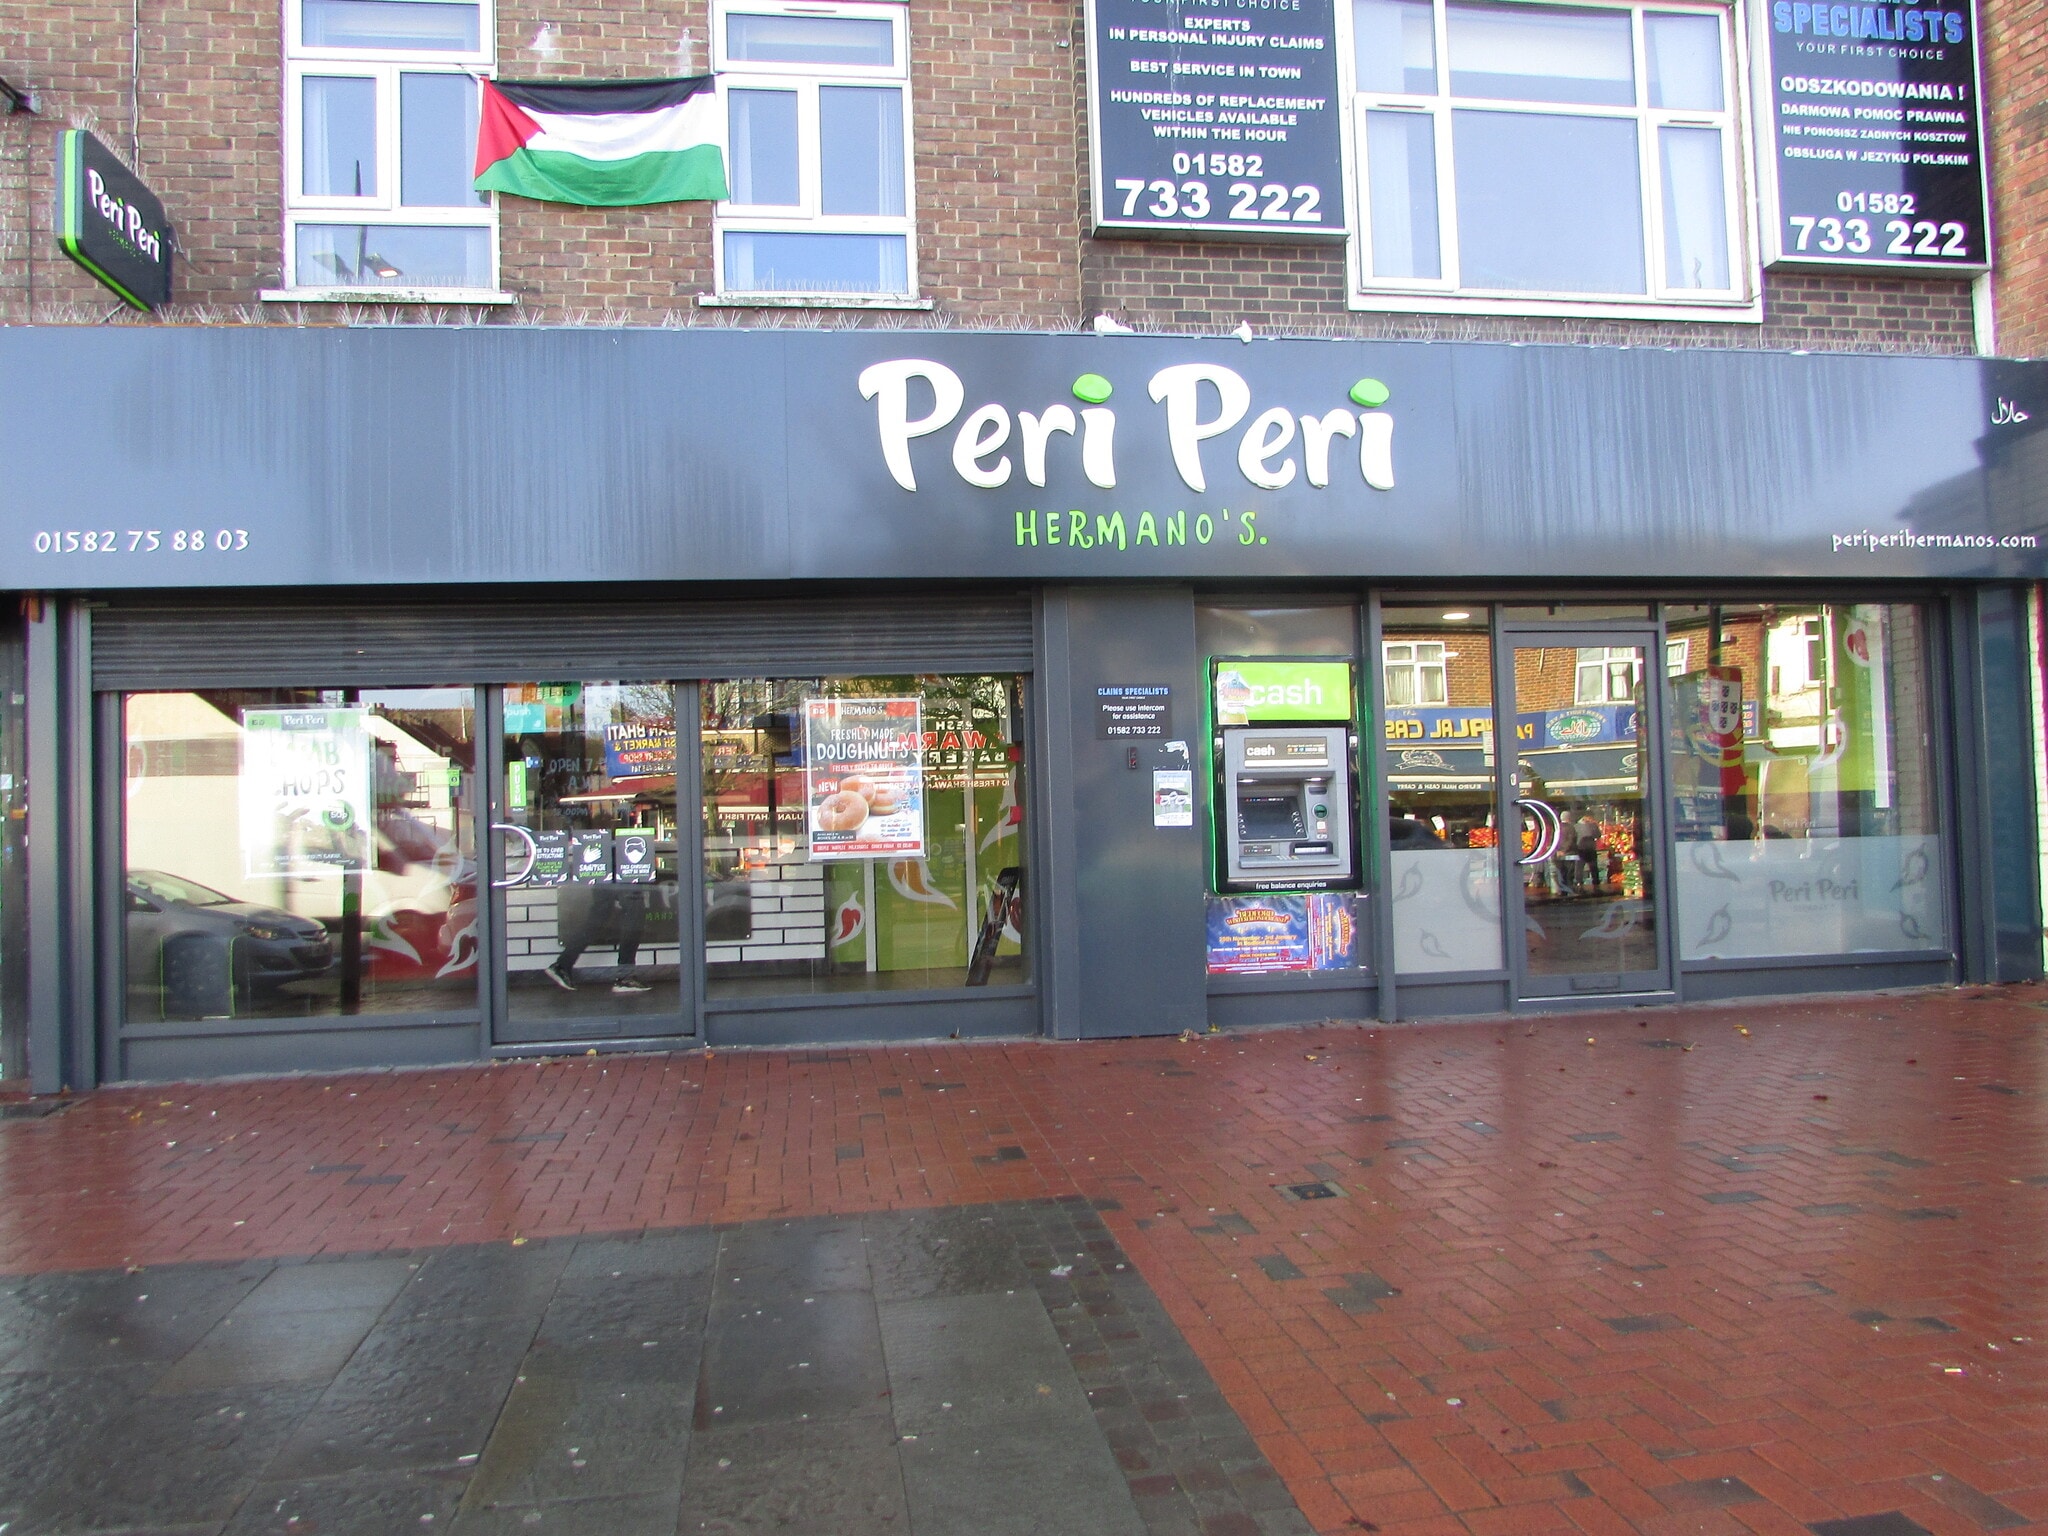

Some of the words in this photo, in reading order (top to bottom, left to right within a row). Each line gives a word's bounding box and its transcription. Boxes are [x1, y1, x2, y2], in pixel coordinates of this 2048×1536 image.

[1185, 17, 1251, 31] EXPERTS
[1773, 1, 1964, 44] SPECIALISTS
[1109, 28, 1125, 41] IN
[1129, 29, 1207, 45] PERSONAL
[1212, 34, 1265, 47] INJURY
[1270, 37, 1324, 50] CLAIMS
[1796, 42, 1837, 54] YOUR
[1841, 45, 1883, 57] FIRST
[1888, 47, 1944, 61] CHOICE
[1130, 61, 1168, 74] BEST
[1173, 62, 1235, 77] SERVICE
[1239, 65, 1255, 77] IN
[1259, 66, 1301, 79] TOWN
[1780, 76, 1953, 100] ODSZKODOWANIA
[1110, 90, 1192, 106] HUNDREDS
[1196, 94, 1215, 106] OF
[1219, 95, 1326, 110] REPLACEMENT
[1141, 109, 1214, 123] VEHICLES
[1218, 111, 1297, 126] AVAILABLE
[1781, 103, 1851, 119] DARMOWA
[1854, 107, 1903, 122] POMOC
[1906, 110, 1965, 124] PRAWNA
[1153, 126, 1207, 139] WITHIN
[1211, 127, 1241, 140] THE
[1245, 129, 1287, 141] HOUR
[1782, 125, 1801, 136] NIE
[1804, 126, 1858, 139] PONOSISZ
[1860, 129, 1911, 142] ZADNYCH
[1172, 152, 1264, 177] 01582
[1784, 146, 1843, 161] OBSLUGA
[1846, 150, 1857, 161] W
[1860, 151, 1910, 164] JEZYKU
[1913, 153, 1969, 166] POLSKIM
[1115, 179, 1212, 219] 733
[1228, 182, 1322, 222] 222
[1837, 191, 1916, 215] 01582
[87, 167, 125, 231] Peri
[126, 204, 161, 264] Peri
[1789, 216, 1872, 254] 733
[1885, 220, 1967, 257] 222
[1991, 396, 2030, 424] حلال
[858, 358, 1116, 493] Peri
[1147, 363, 1395, 493] Peri
[35, 531, 118, 553] 01582
[128, 529, 162, 552] 75
[173, 529, 206, 551] 88
[216, 529, 249, 551] 03
[1832, 529, 2037, 553] periperihermanos.com
[1097, 687, 1123, 696] CLAIMS
[1125, 687, 1169, 696] SPECIALISTS
[1250, 677, 1322, 705] cash
[1102, 704, 1124, 712] Please
[1138, 704, 1165, 712] intercom
[831, 728, 868, 741] FRESHLY
[871, 728, 894, 741] MADE
[1107, 726, 1131, 735] 01582
[1132, 726, 1146, 734] 733
[1147, 726, 1161, 734] 222
[816, 741, 909, 761] DOUGHNUTS
[1246, 744, 1275, 756] cash
[818, 780, 838, 793] NEW
[1255, 882, 1270, 890] free
[1270, 882, 1296, 890] balance
[1297, 881, 1327, 890] enquiries
[1768, 879, 1810, 902] Peri
[1815, 878, 1859, 900] Peri
